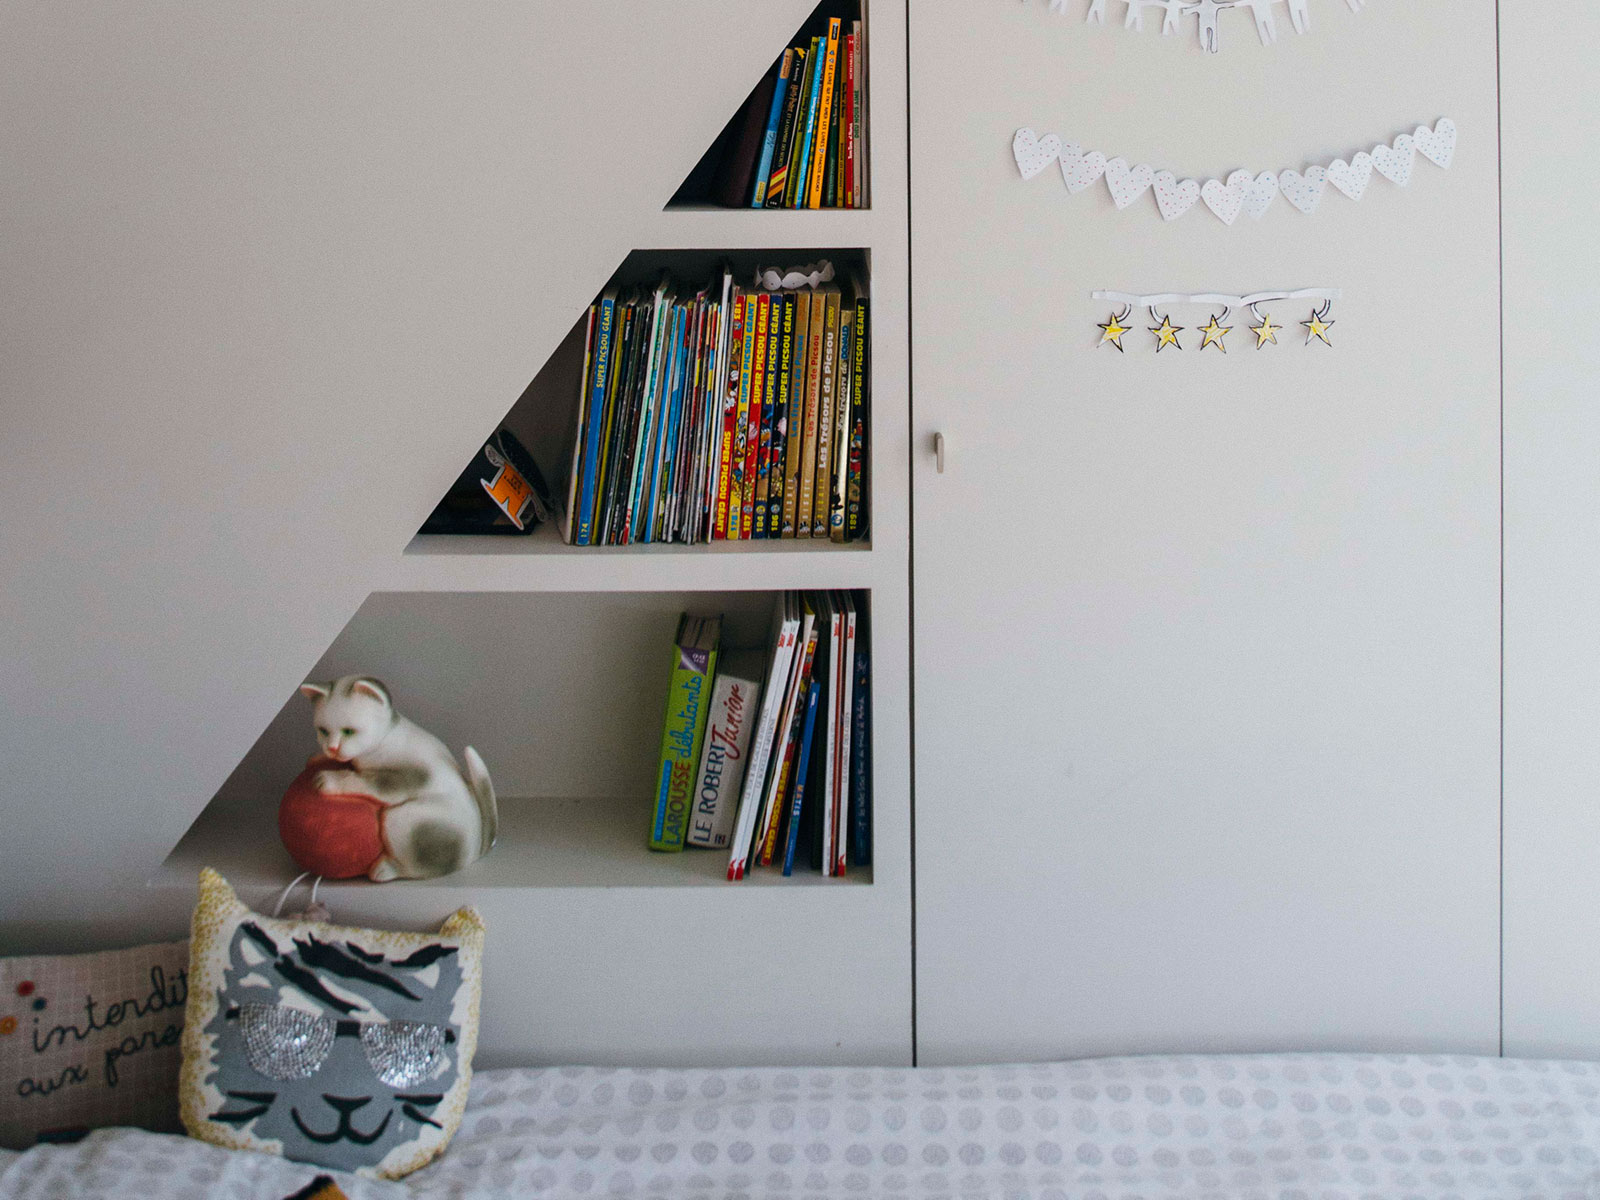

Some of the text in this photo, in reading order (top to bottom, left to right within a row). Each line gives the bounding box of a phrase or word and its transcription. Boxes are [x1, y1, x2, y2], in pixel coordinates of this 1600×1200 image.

[786, 97, 797, 113] Potter
[789, 84, 799, 97] Harry
[596, 306, 611, 388] SUPER PICSOU GÉANT
[734, 303, 742, 320] 183
[827, 305, 835, 328] PICSOU
[841, 325, 850, 360] DONALD
[740, 302, 755, 403] SUPER PICSOU GÉANT
[753, 302, 767, 404] SUPER PICSOU GÉANT
[766, 303, 780, 405] SUPER PICSOU GÉANT
[779, 302, 793, 404] SUPER PICSOU GÉANT
[806, 335, 820, 437] Les Trésors de Picsou
[840, 361, 848, 374] de
[854, 304, 865, 405] SUPER PICSOU GÉANT
[819, 332, 834, 468] Les Trésors de Picsou
[716, 431, 732, 532] SUPER PICSOU GÉANT
[580, 523, 588, 538] 174
[743, 515, 751, 532] 187
[756, 515, 764, 532] 184
[771, 514, 779, 532] 186
[670, 675, 703, 759] débutants
[711, 684, 745, 760] Junior
[666, 761, 692, 846] LAROUSSE
[700, 743, 726, 815] ROBERT
[771, 793, 783, 828] PICSOU
[778, 761, 789, 792] SUPER
[694, 818, 713, 843] LE
[32, 964, 189, 1053] interdit
[17, 1023, 183, 1098] aux pare
